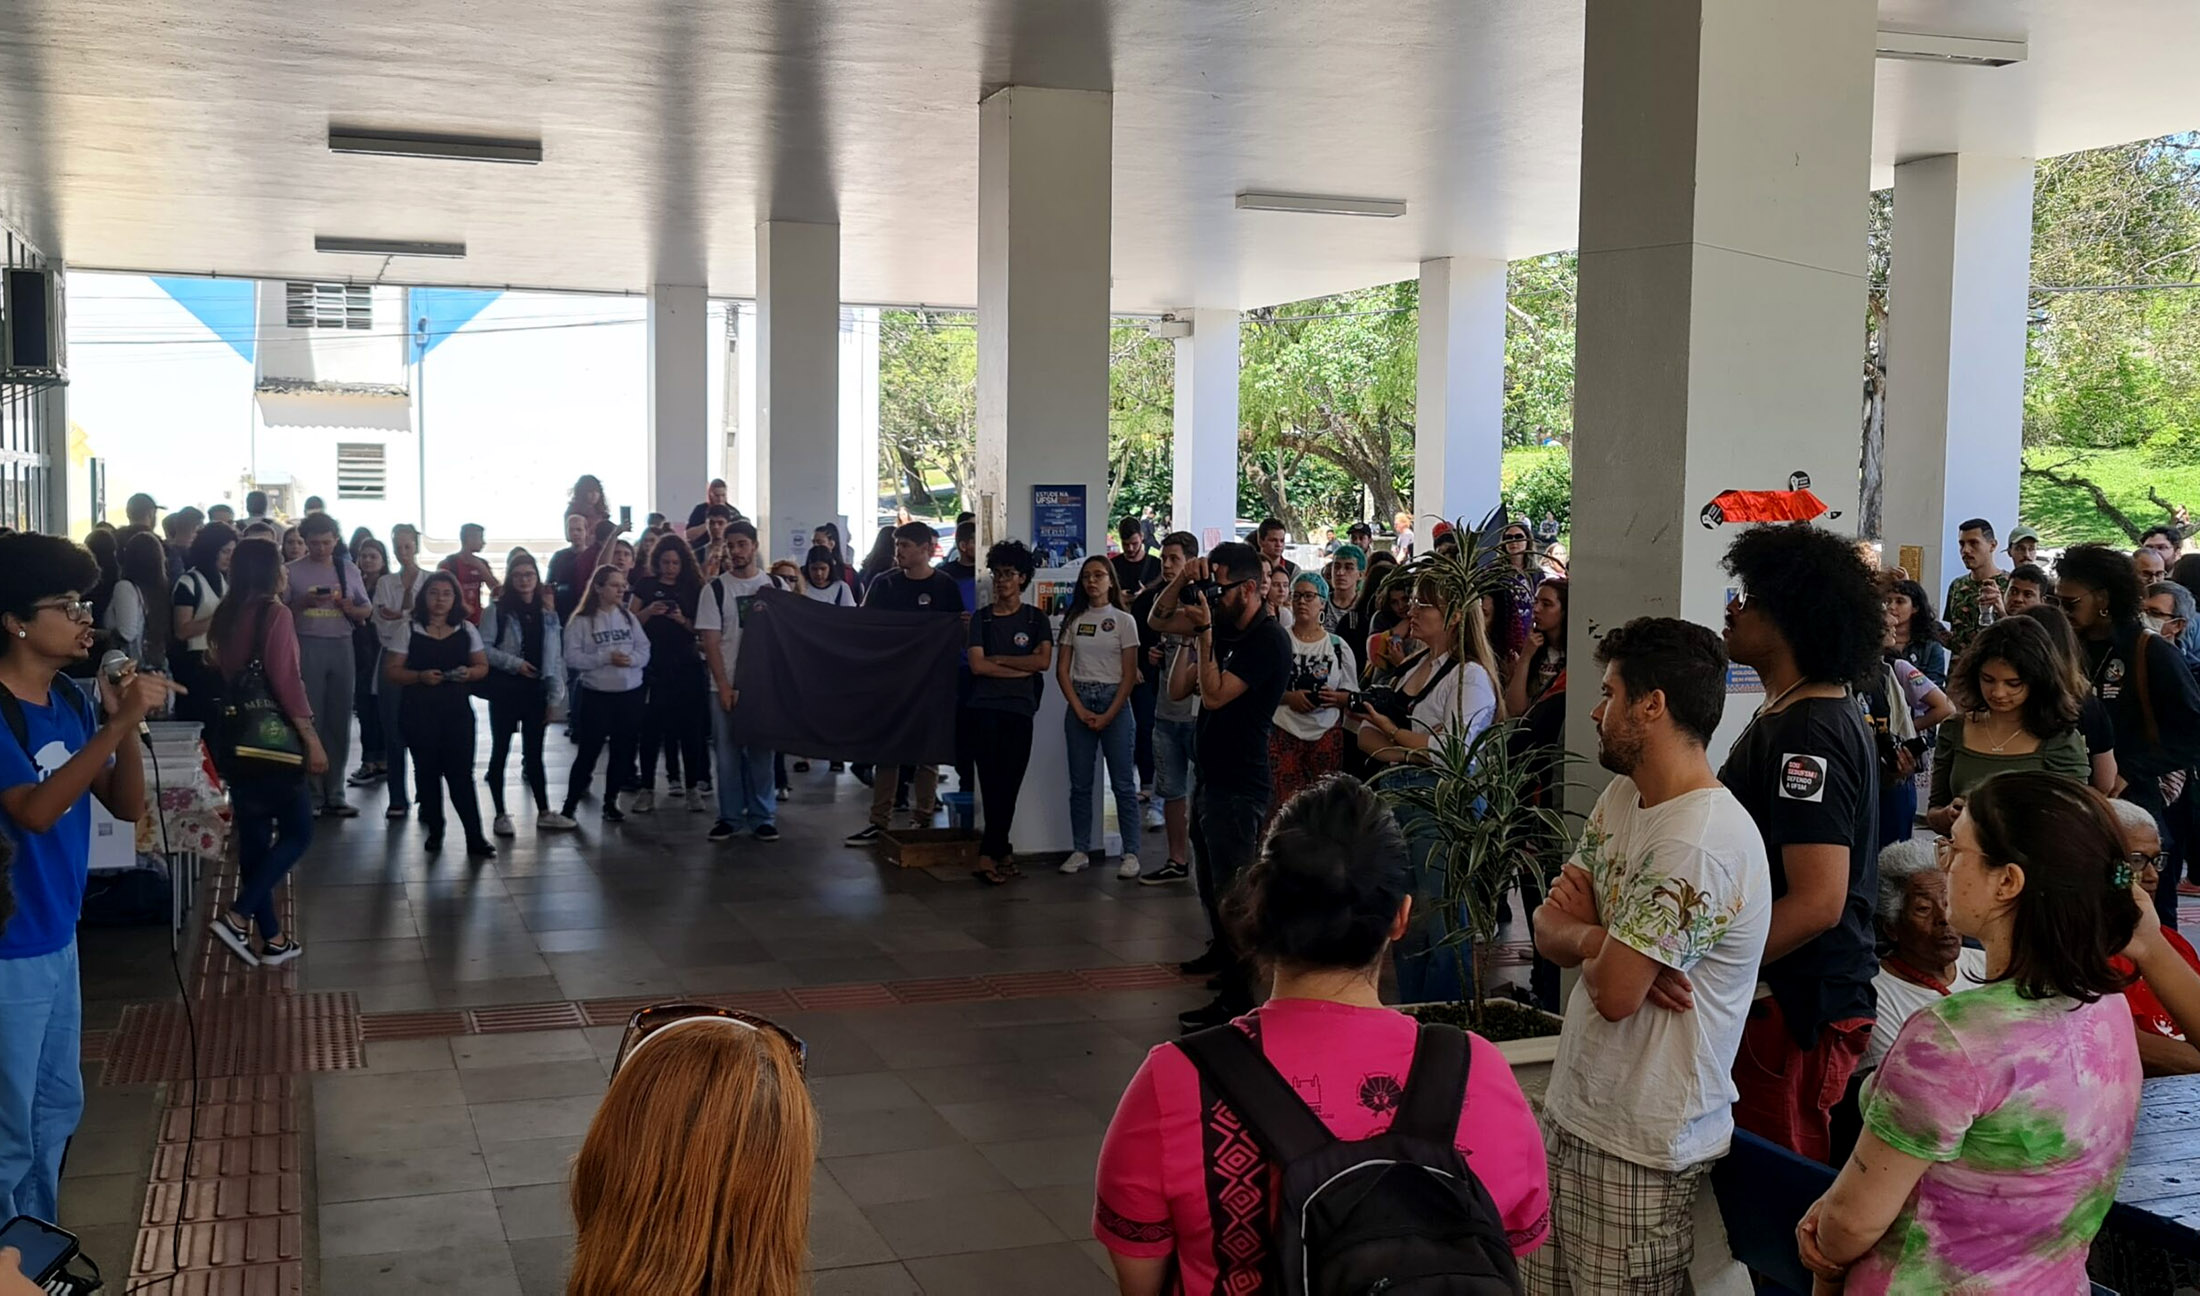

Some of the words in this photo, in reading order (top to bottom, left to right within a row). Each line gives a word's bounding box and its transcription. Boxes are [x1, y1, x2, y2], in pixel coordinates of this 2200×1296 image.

[1035, 496, 1058, 504] UFSM
[592, 629, 632, 644] UFSM
[1786, 775, 1812, 785] DEFENDO
[1790, 783, 1807, 791] UFSM
